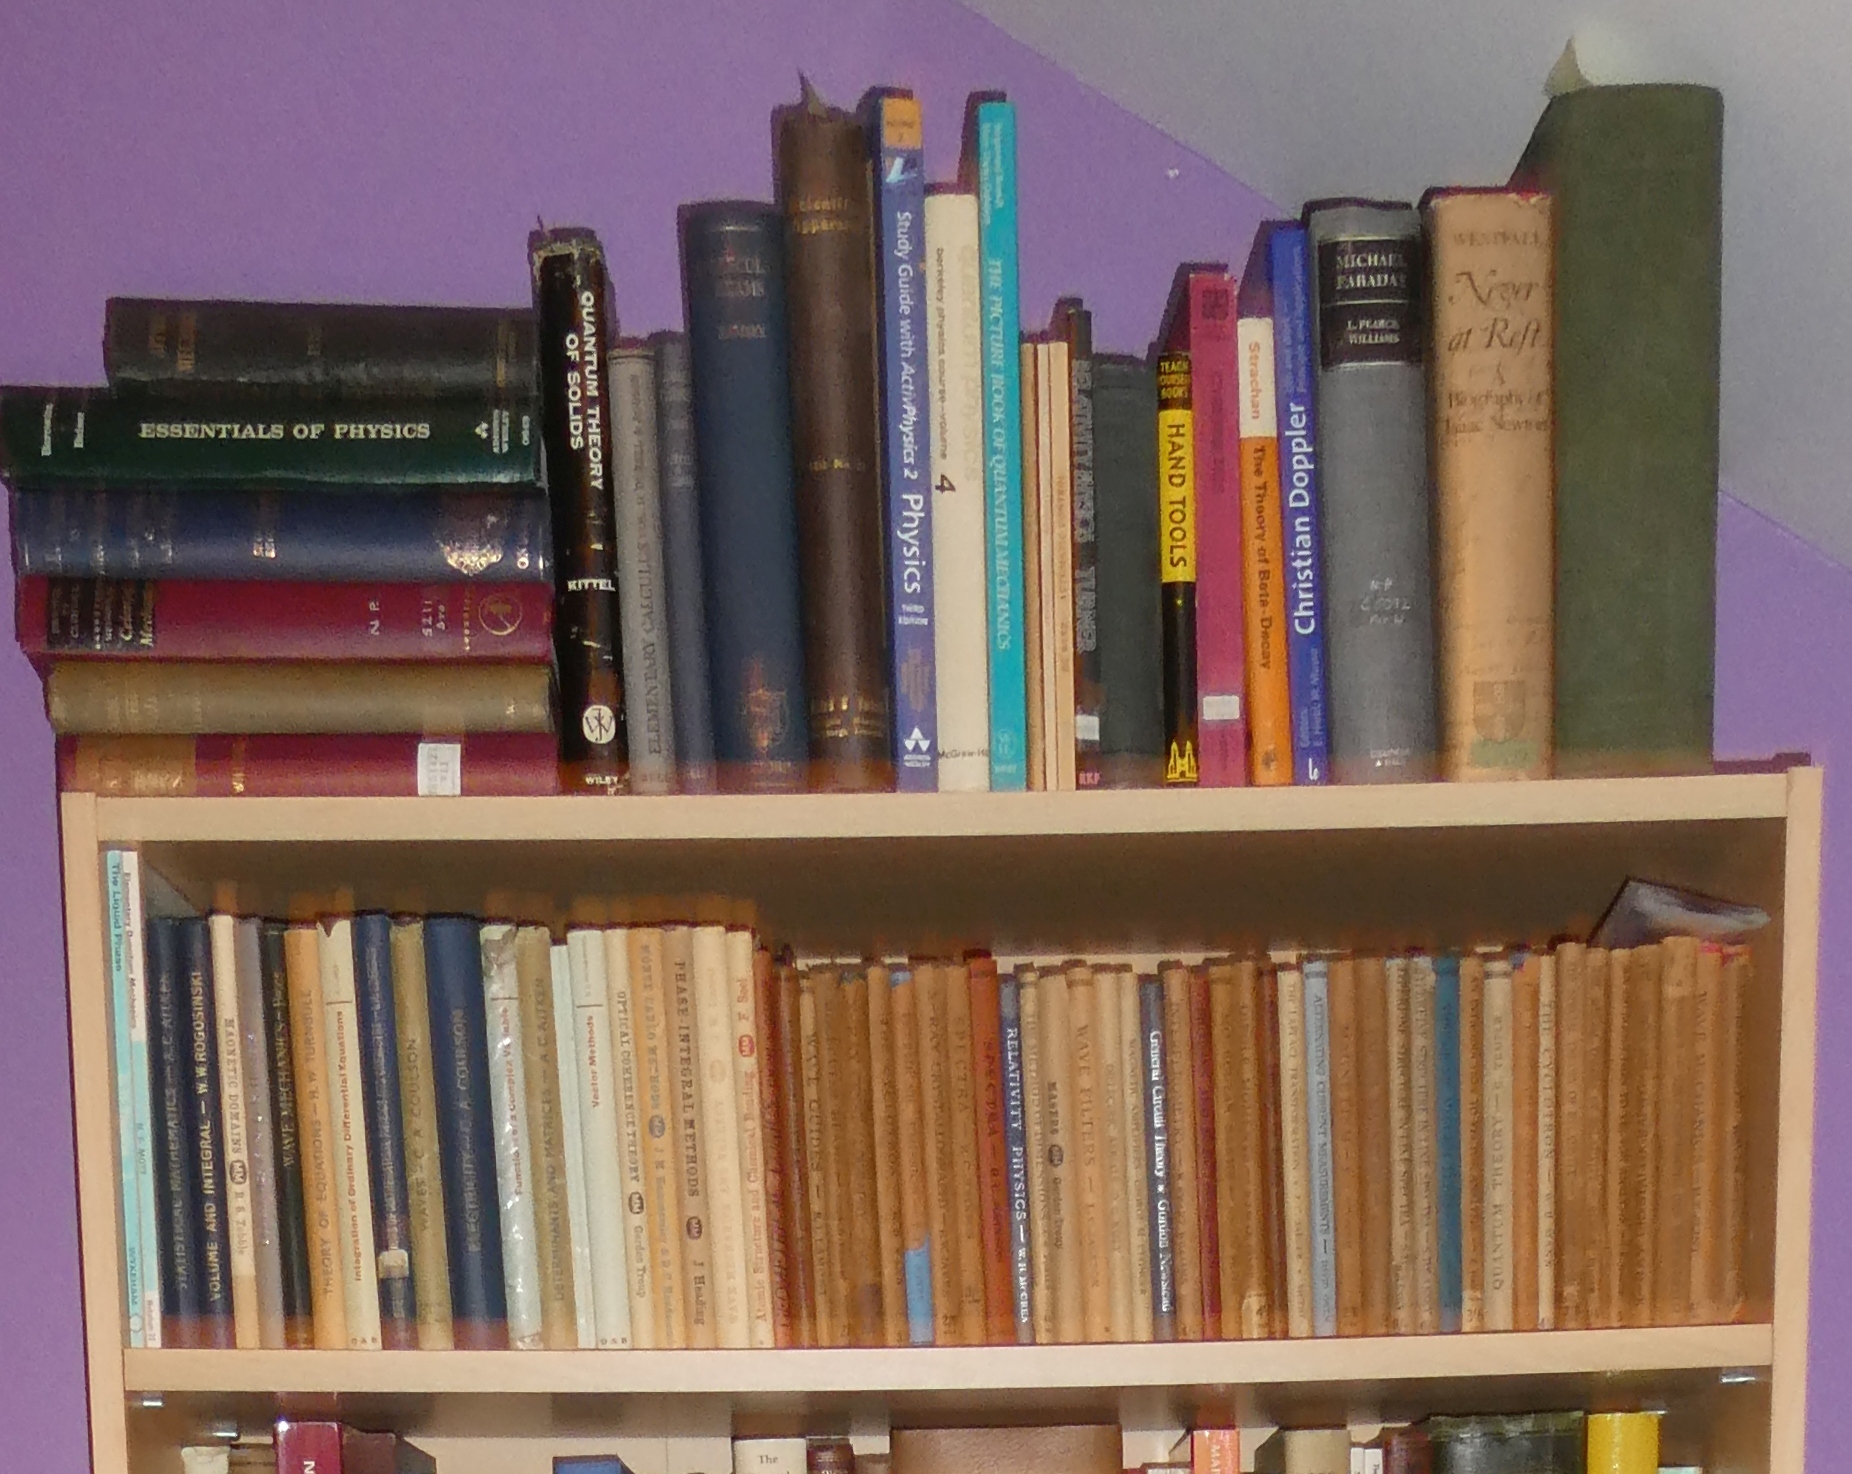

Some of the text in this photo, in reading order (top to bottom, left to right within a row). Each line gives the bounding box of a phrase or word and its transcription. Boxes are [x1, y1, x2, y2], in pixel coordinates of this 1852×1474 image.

[896, 211, 915, 357] Study Guide with
[1336, 253, 1405, 269] MICHAEL
[139, 422, 431, 440] ESSENTIALS OF PHYSICS
[566, 333, 584, 451] OF SOLIDS
[581, 291, 605, 491] QUANTUM THEORY
[1248, 343, 1261, 419] Strachan
[936, 474, 956, 494] 4
[988, 259, 1011, 649] THE PICTURE BOOK QUANTUM MECHANICS
[1167, 424, 1187, 568] HAND TOOLS
[1286, 402, 1315, 634] Christian Doppler
[567, 579, 616, 592] KITTEL
[897, 494, 927, 594] Physics
[1252, 446, 1272, 669] The Theory of Beta-Decay
[111, 864, 123, 972] The Liquid Phase
[228, 1094, 242, 1153] DOMAINS
[585, 1016, 600, 1108] Vector Methods
[617, 991, 639, 1182] OPTICAL COHERENCE THEORY
[1006, 1027, 1024, 1221] RELATIVITY PHYSICS
[1149, 1030, 1166, 1179] General Circuit Theory
[335, 1010, 362, 1281] Integration of Ordinary Differential Equations
[674, 961, 706, 1326] PHASE-INTEGRAL METHODS Heading
[200, 1120, 220, 1301] VOLUME AND INTEGRAL
[317, 1238, 334, 1294] THEORY
[759, 1453, 779, 1465] The
